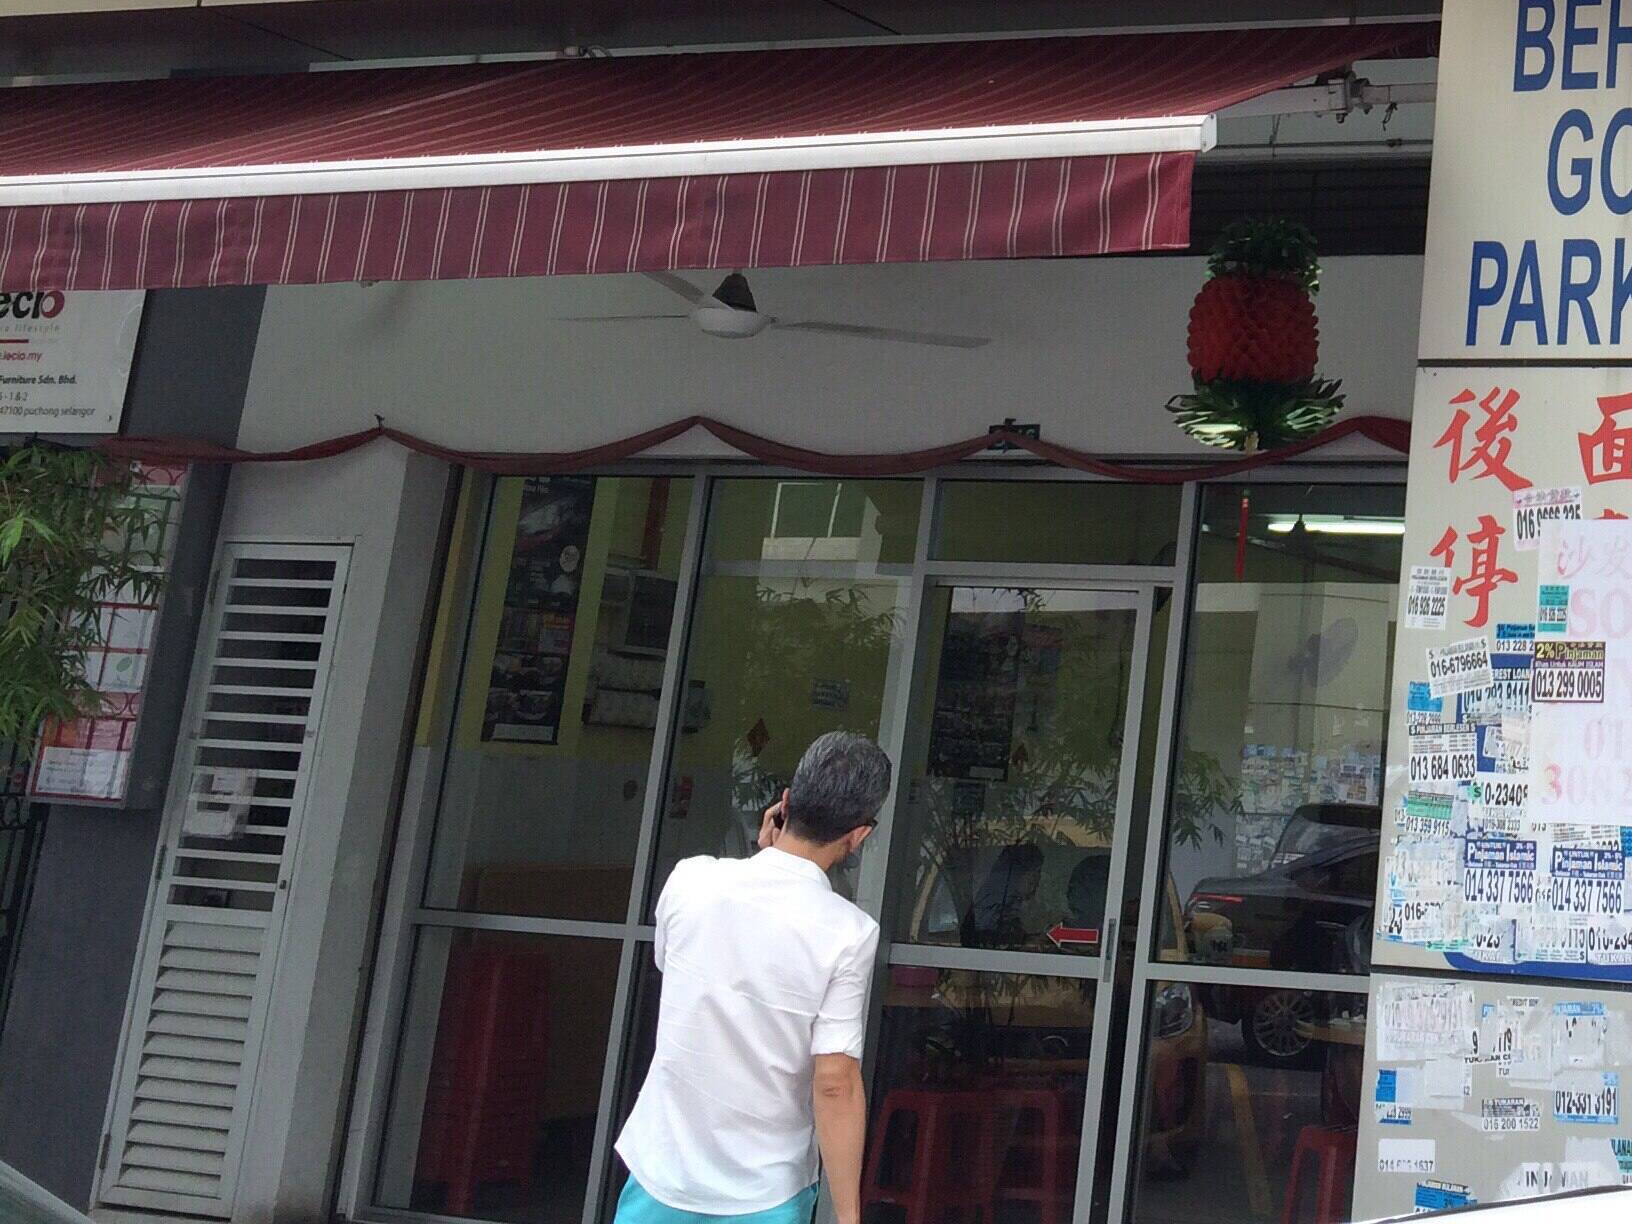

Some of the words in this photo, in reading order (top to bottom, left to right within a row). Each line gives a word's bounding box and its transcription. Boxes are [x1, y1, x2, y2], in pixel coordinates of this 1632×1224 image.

[1536, 643, 1555, 659] 2%
[1536, 670, 1554, 698] 013
[1556, 670, 1575, 698] 299
[1576, 669, 1602, 698] 0005
[1411, 756, 1428, 781] 013
[1431, 755, 1449, 779] 684
[1452, 754, 1476, 778] 0633
[1465, 869, 1484, 902] 014
[1486, 870, 1506, 903] 337
[1508, 870, 1534, 904] 7566
[1552, 878, 1571, 912] 014
[1573, 881, 1593, 912] 337
[1596, 881, 1622, 914] 7566
